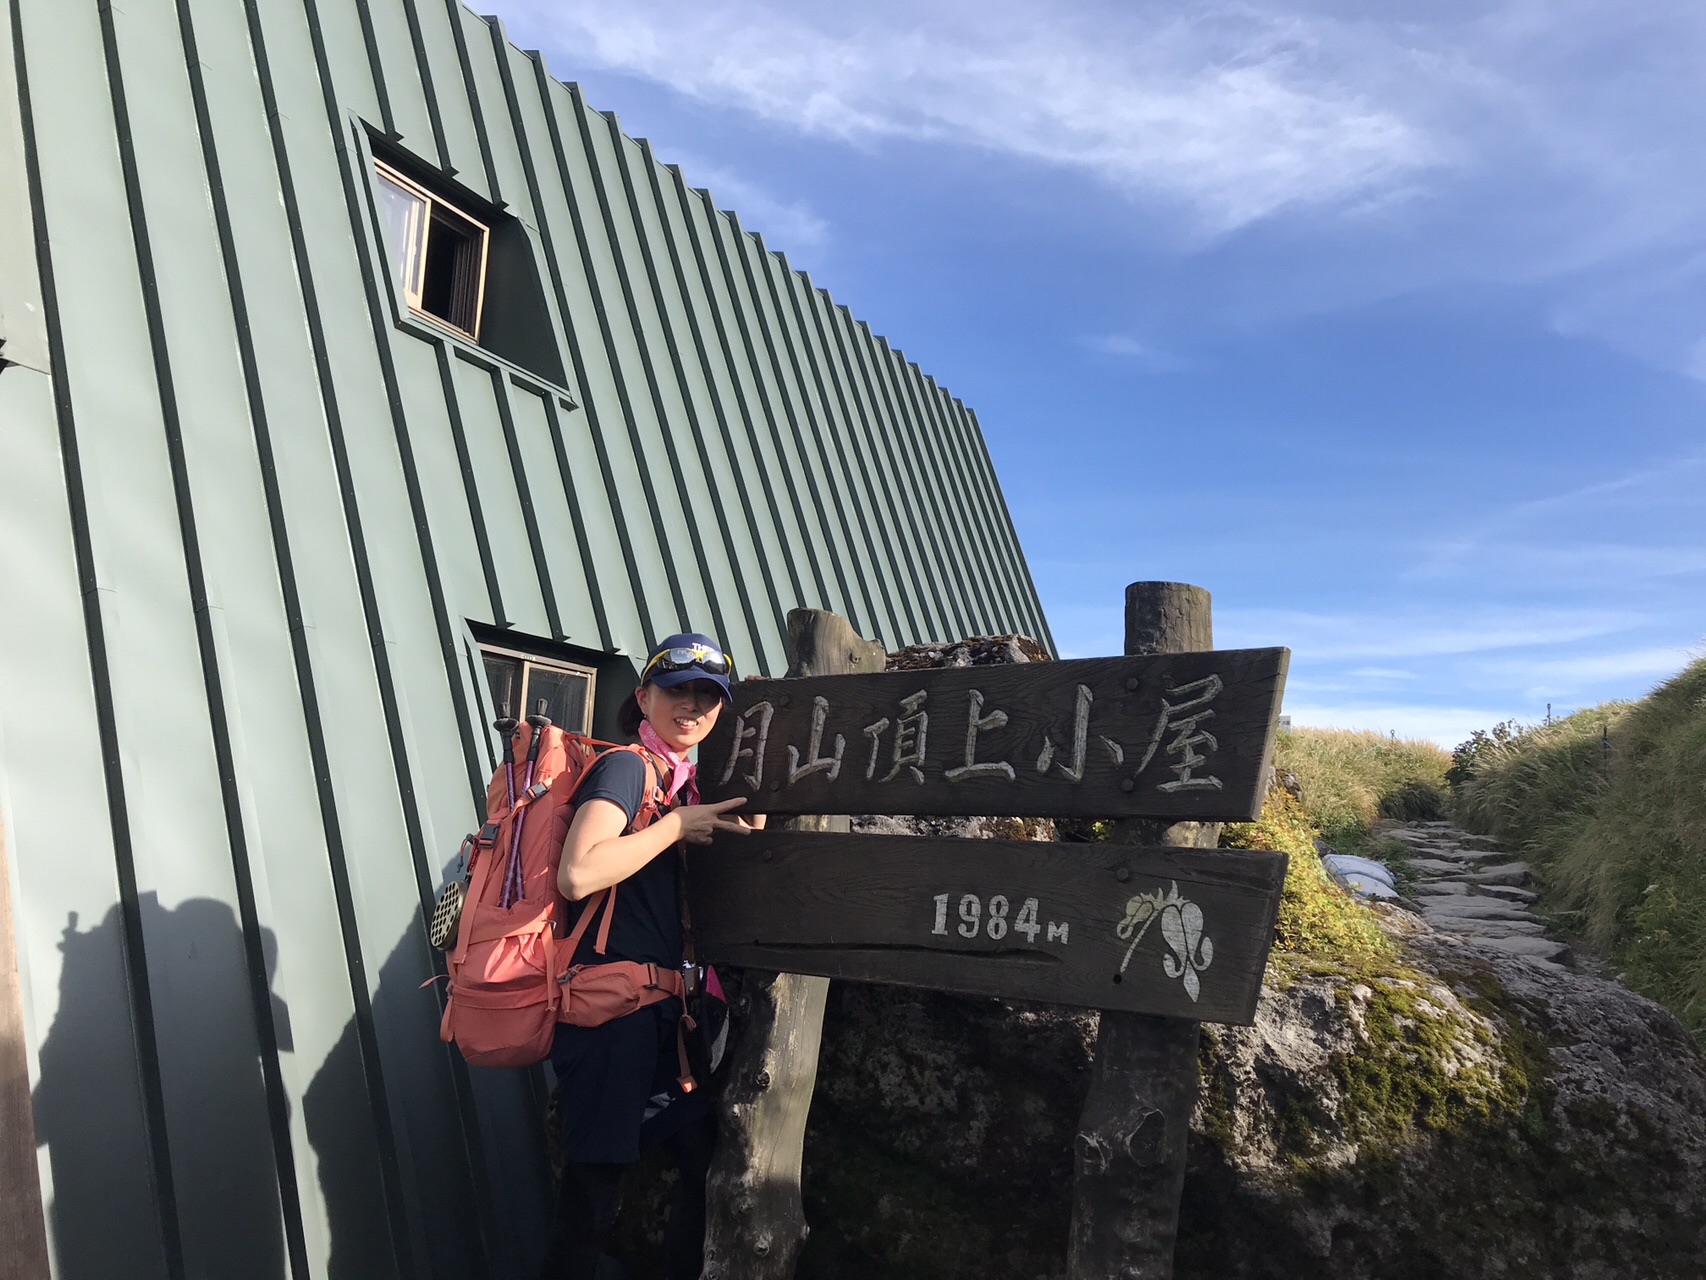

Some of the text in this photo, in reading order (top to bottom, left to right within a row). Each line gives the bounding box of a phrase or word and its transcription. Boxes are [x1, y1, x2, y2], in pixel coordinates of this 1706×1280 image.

[719, 673, 1224, 792] 月山頂上小屋
